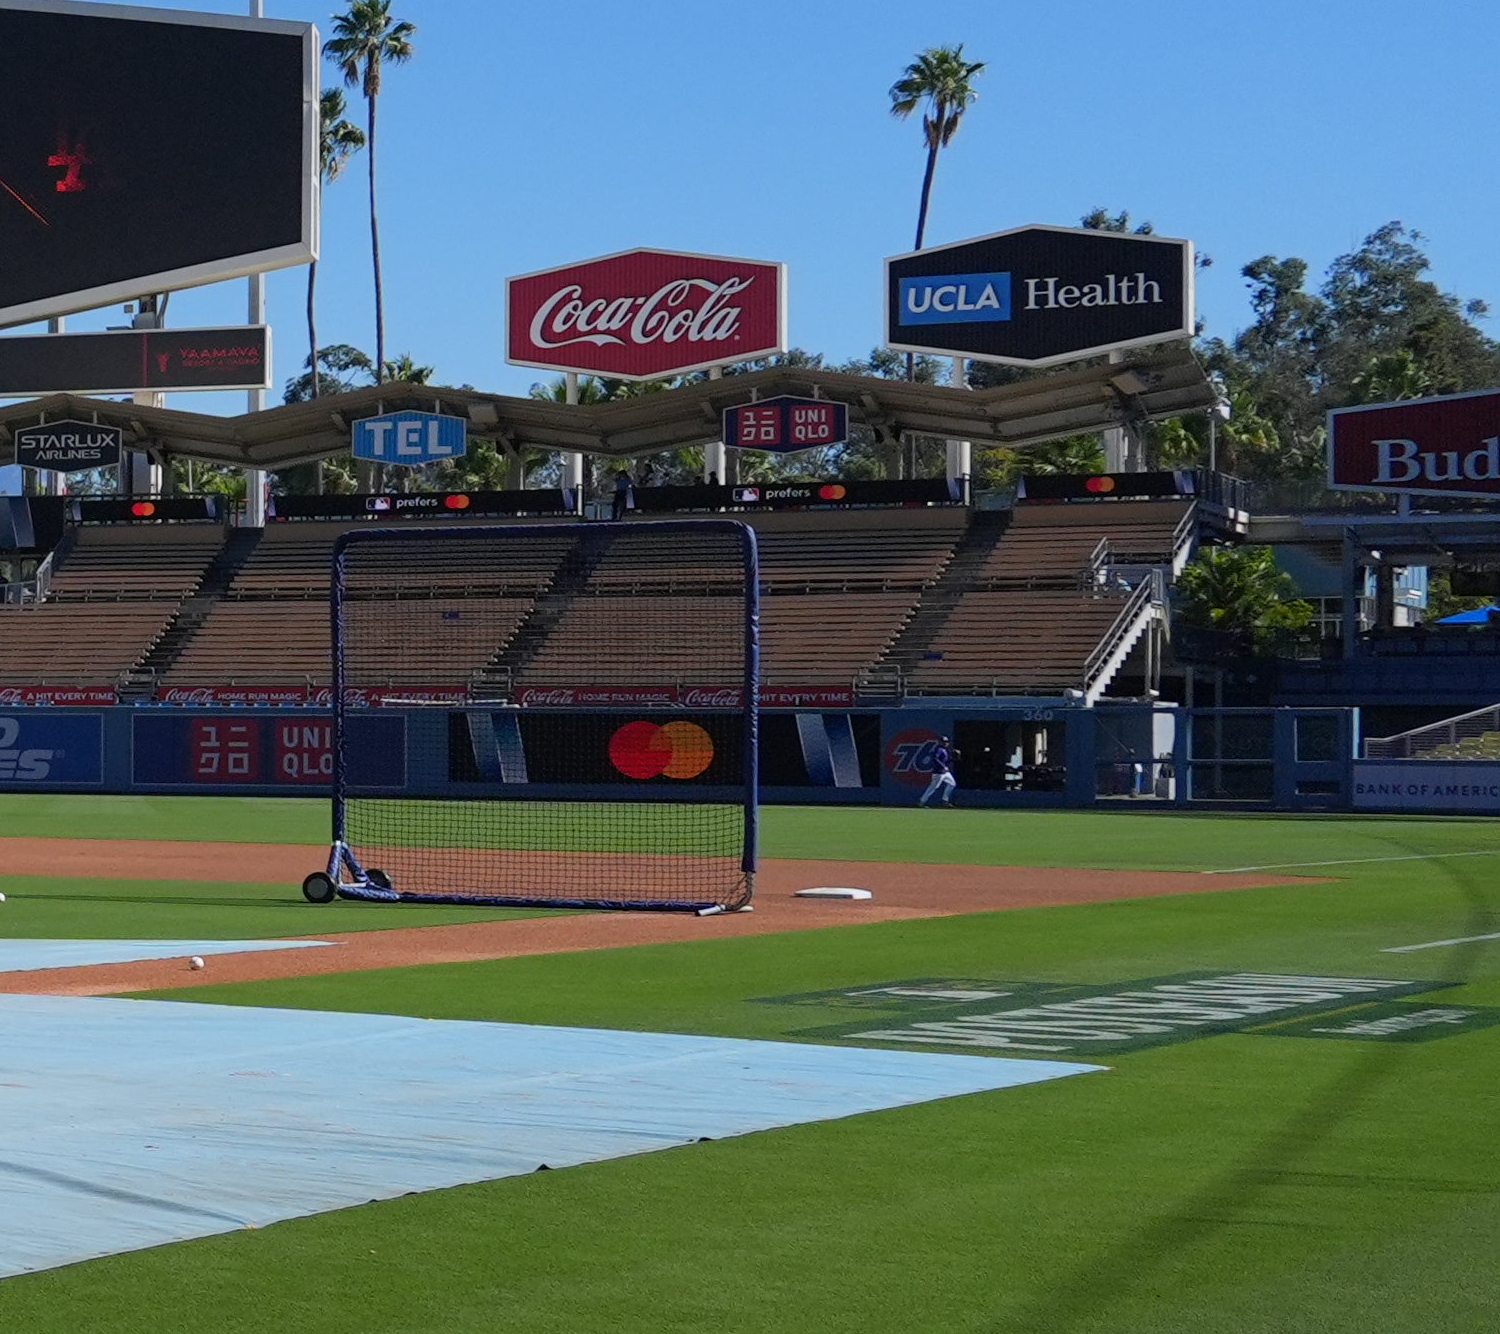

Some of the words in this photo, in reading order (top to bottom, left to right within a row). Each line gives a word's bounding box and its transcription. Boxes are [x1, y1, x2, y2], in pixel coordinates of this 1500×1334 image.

[907, 283, 1001, 314] UCLA
[1024, 272, 1164, 310] Health
[530, 275, 756, 349] Coca-Cola
[742, 410, 776, 425] ユニ
[795, 408, 827, 424] UNI
[365, 420, 453, 456] TEL
[741, 426, 775, 441] クロ
[795, 424, 830, 441] QLO
[21, 433, 116, 450] STARLUX
[35, 448, 101, 461] AIRLINES
[765, 487, 811, 500] prefers
[396, 496, 438, 509] prefers
[26, 693, 34, 701] A
[36, 692, 52, 701] HIT
[54, 693, 86, 701] EVERY
[88, 693, 114, 701] TIME
[165, 687, 217, 703] Coca-Cola
[217, 692, 247, 701] HOME
[248, 692, 268, 701] RUN
[270, 692, 303, 702] MAGIC
[685, 688, 742, 707] Coca-Cola
[779, 693, 817, 703] EVRY
[820, 693, 850, 702] TIME
[893, 739, 940, 773] 76
[1356, 782, 1402, 795] BANK
[1407, 784, 1429, 796] OF
